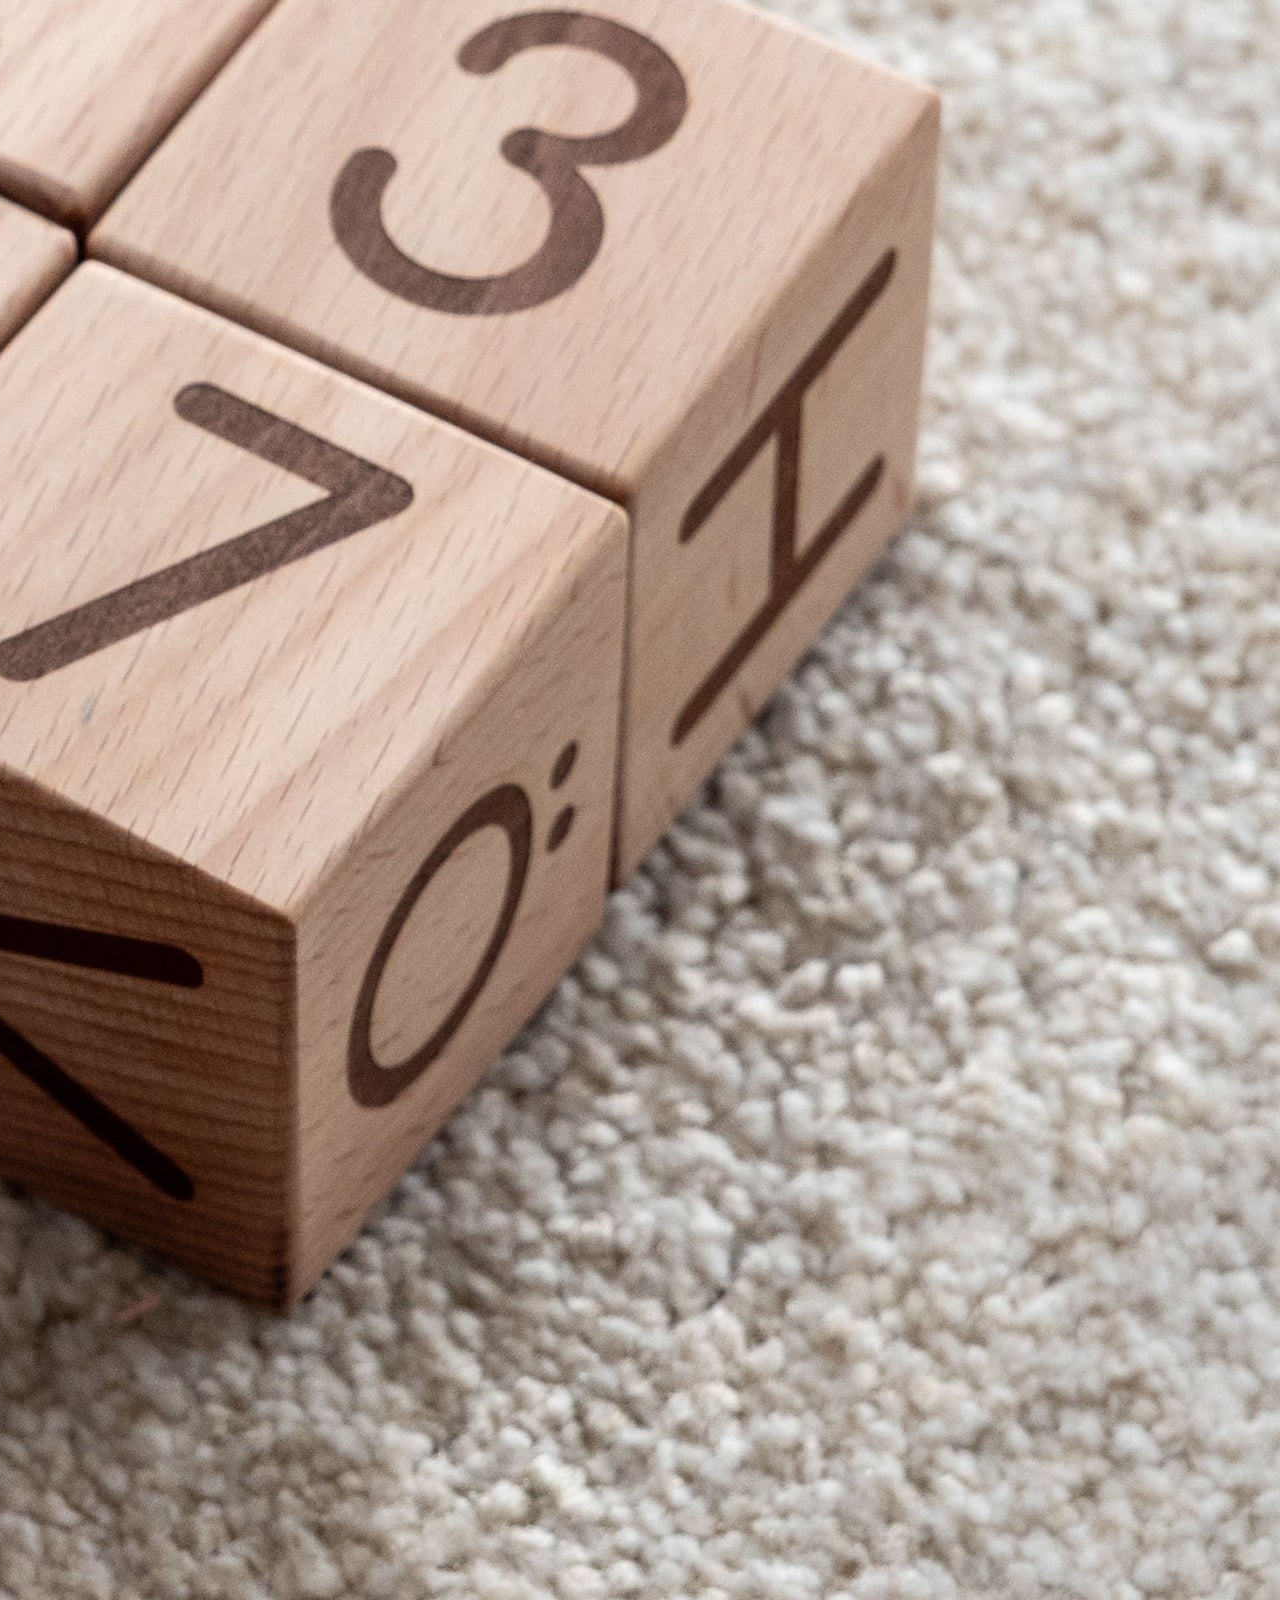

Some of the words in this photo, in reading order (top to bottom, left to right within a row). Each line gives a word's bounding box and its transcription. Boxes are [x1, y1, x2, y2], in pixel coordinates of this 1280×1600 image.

[330, 8, 690, 317] 3
[671, 250, 898, 747] H
[346, 738, 582, 1110] Ö
